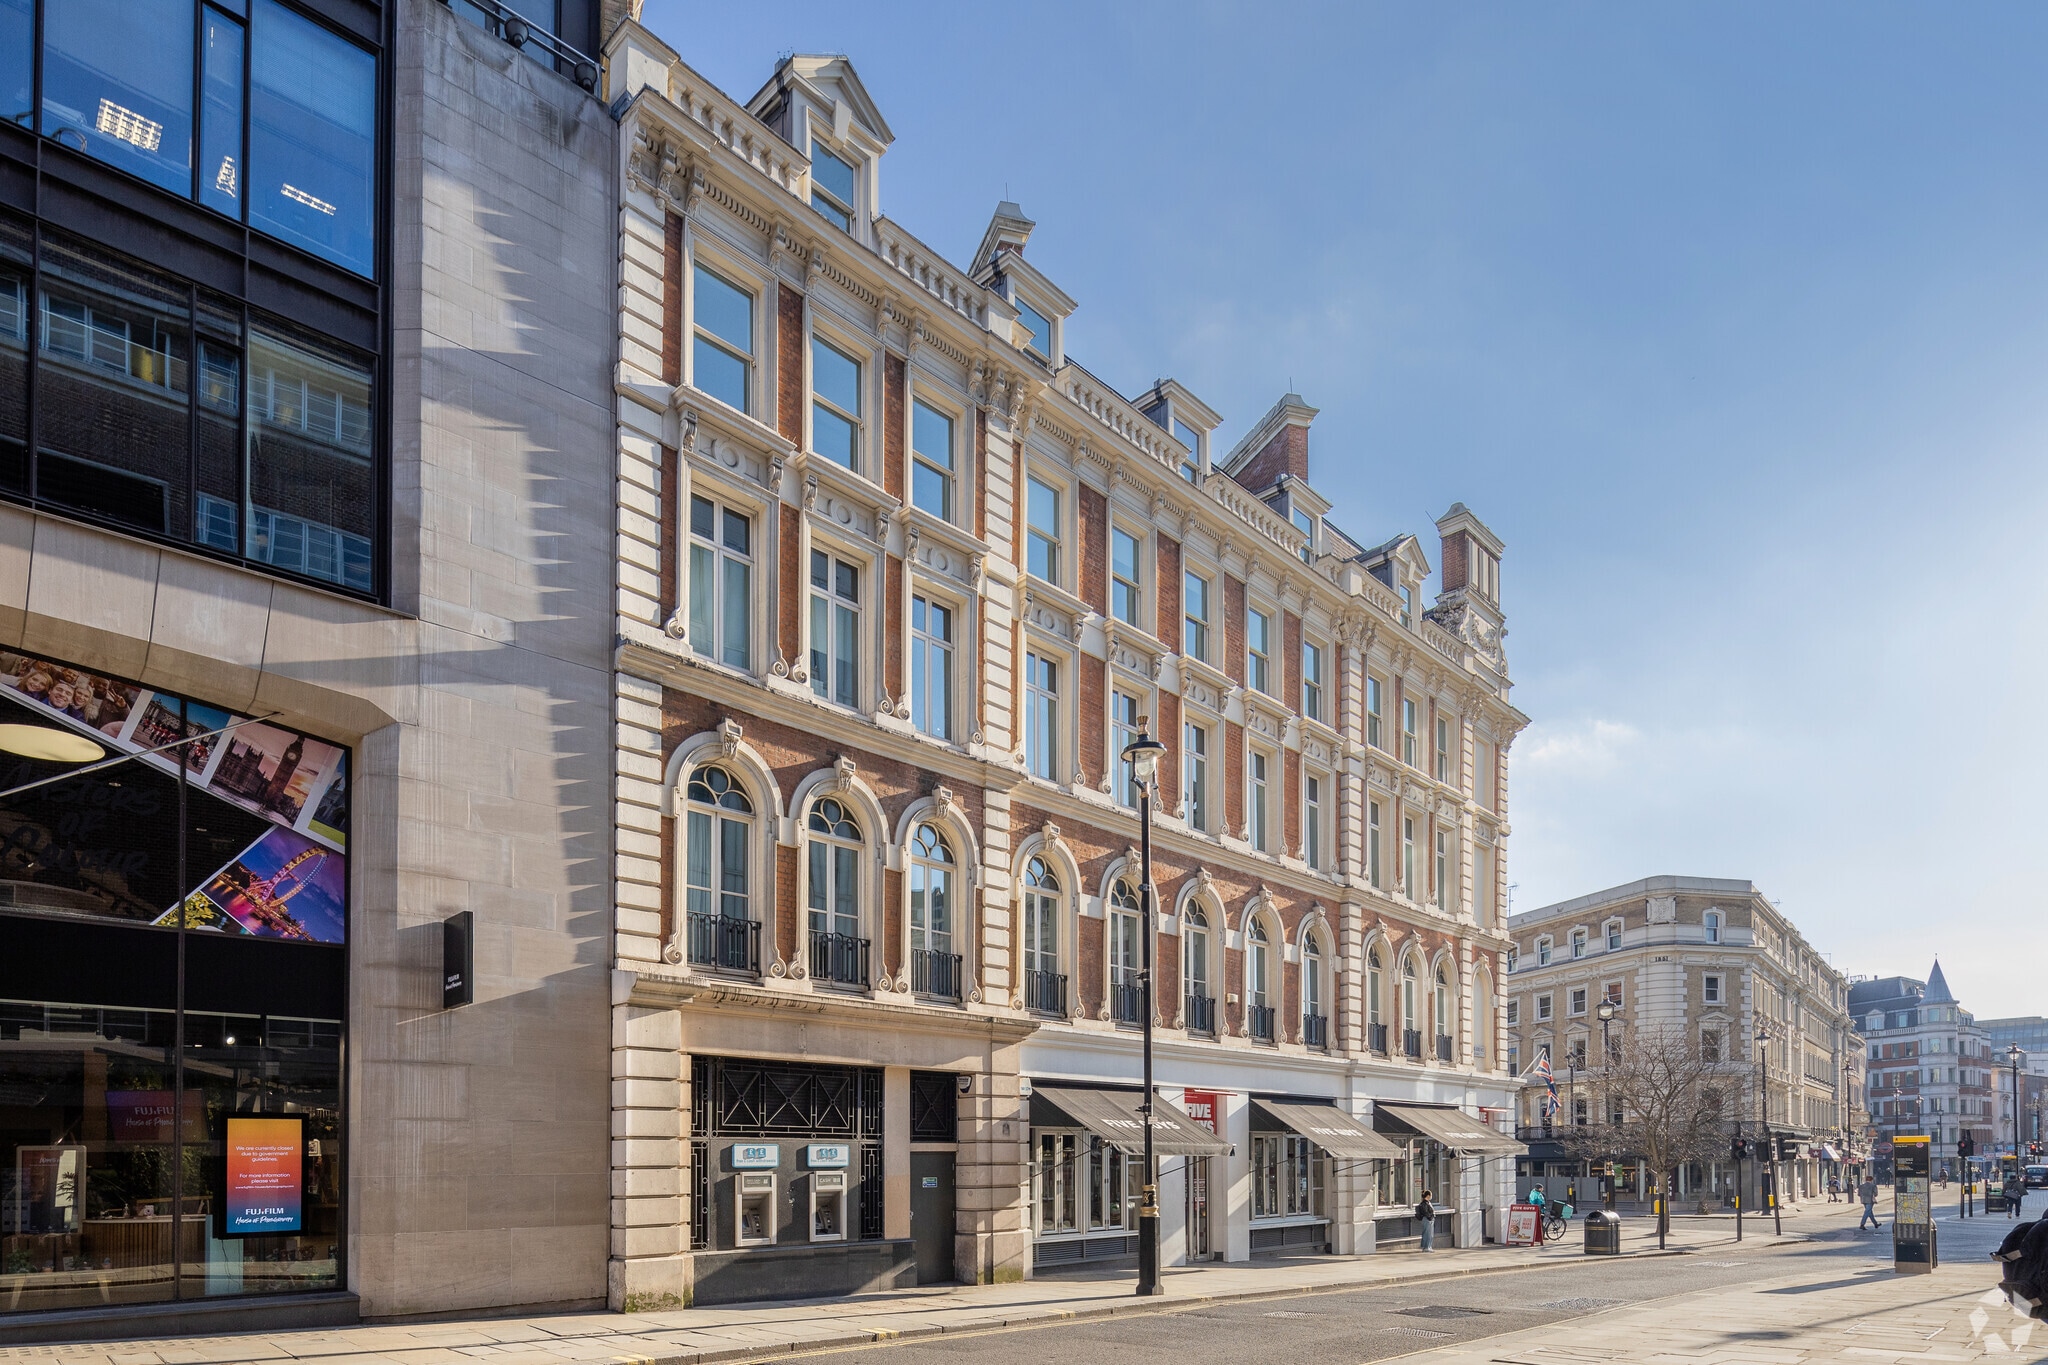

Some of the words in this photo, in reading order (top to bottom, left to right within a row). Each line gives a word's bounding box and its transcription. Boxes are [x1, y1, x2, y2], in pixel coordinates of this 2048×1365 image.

[134, 1106, 176, 1115] FUJIFIL
[1186, 1103, 1211, 1118] FIVE
[1101, 1119, 1141, 1129] FIVE
[245, 1207, 284, 1215] FUJIFILM
